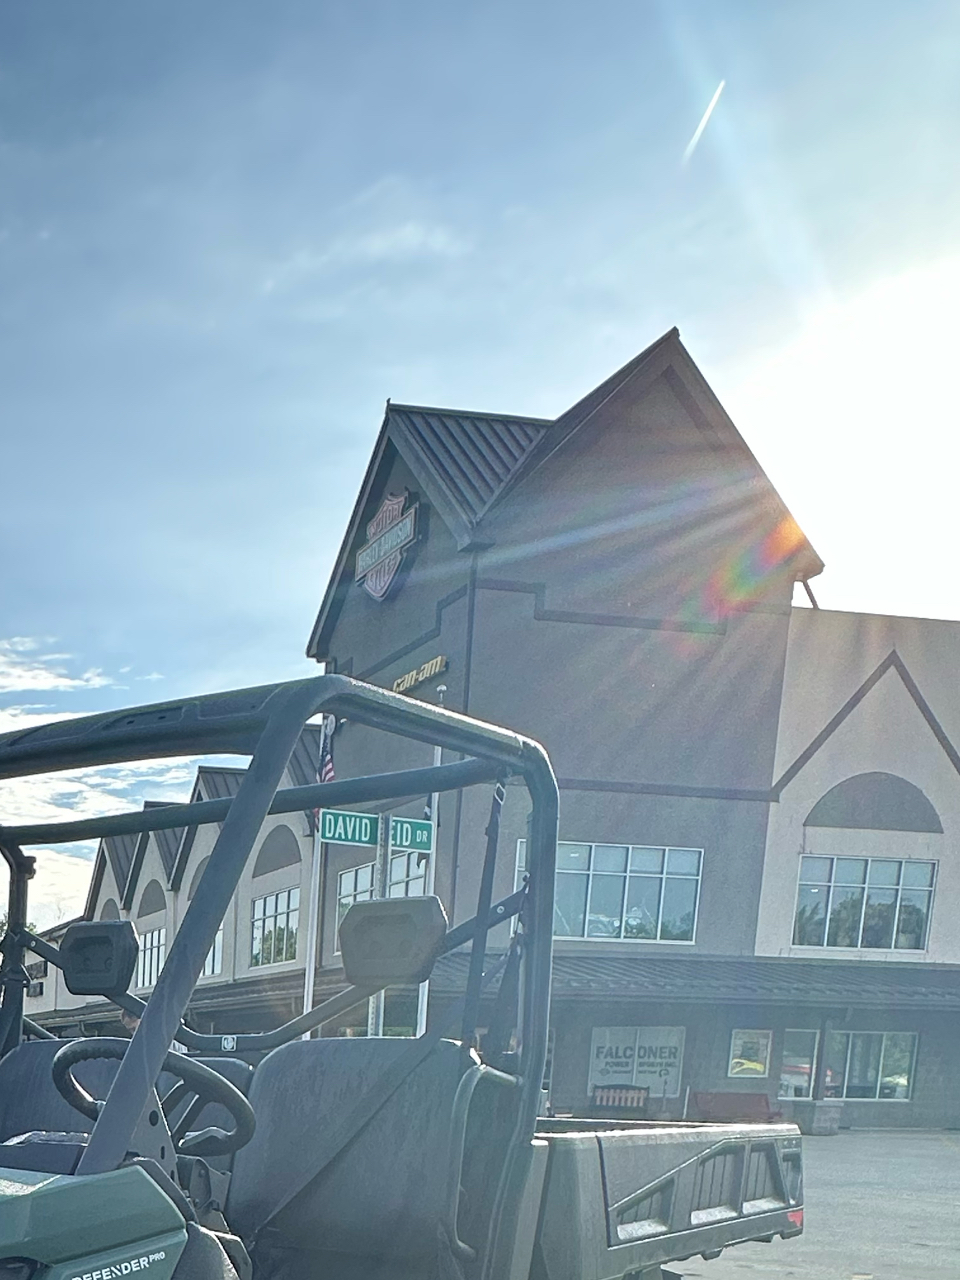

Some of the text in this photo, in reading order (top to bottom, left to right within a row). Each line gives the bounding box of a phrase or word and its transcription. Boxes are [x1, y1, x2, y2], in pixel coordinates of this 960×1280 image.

[393, 655, 442, 693] can-am
[325, 814, 371, 842] DAVID
[416, 830, 428, 843] DR
[596, 1046, 679, 1060] FALCONER
[149, 1251, 166, 1263] PRO
